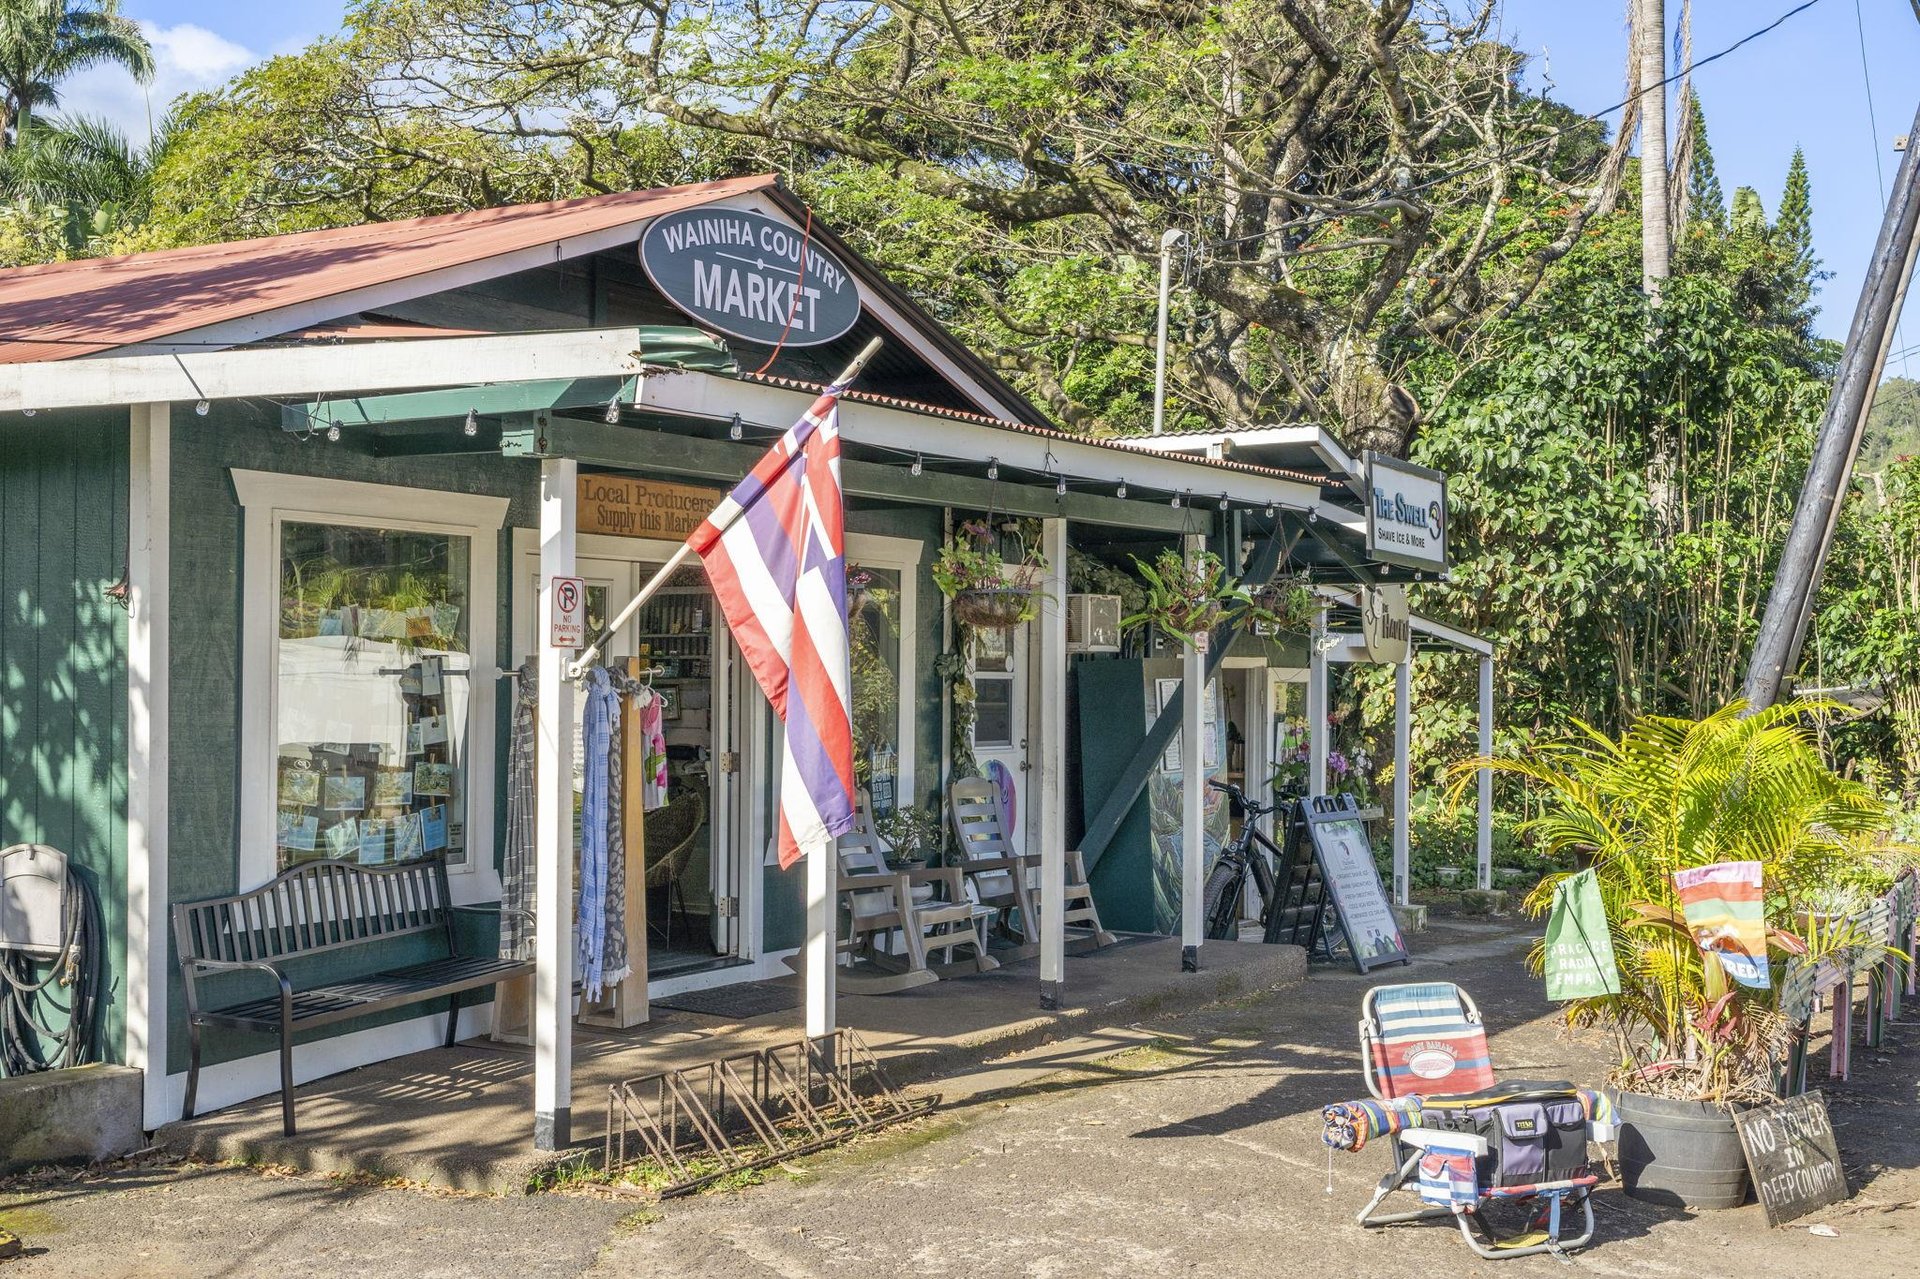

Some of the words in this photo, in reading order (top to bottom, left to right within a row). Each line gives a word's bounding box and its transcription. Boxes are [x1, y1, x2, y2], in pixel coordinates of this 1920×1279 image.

[662, 218, 755, 254] WAINIHA
[760, 226, 846, 294] COUNTRY
[694, 259, 821, 333] MARKET
[584, 479, 630, 504] Local
[635, 485, 715, 513] Producers
[597, 505, 637, 533] Supply
[640, 509, 661, 531] this
[665, 511, 704, 532] Marke
[1411, 534, 1426, 548] MORE
[554, 624, 581, 633] PARKING
[563, 615, 571, 623] NO
[1745, 1118, 1776, 1157] NO
[1775, 1102, 1831, 1145] TOWER
[1784, 1145, 1805, 1169] IN
[1761, 1172, 1795, 1208] DEEP
[1795, 1158, 1838, 1199] COUNTRY
